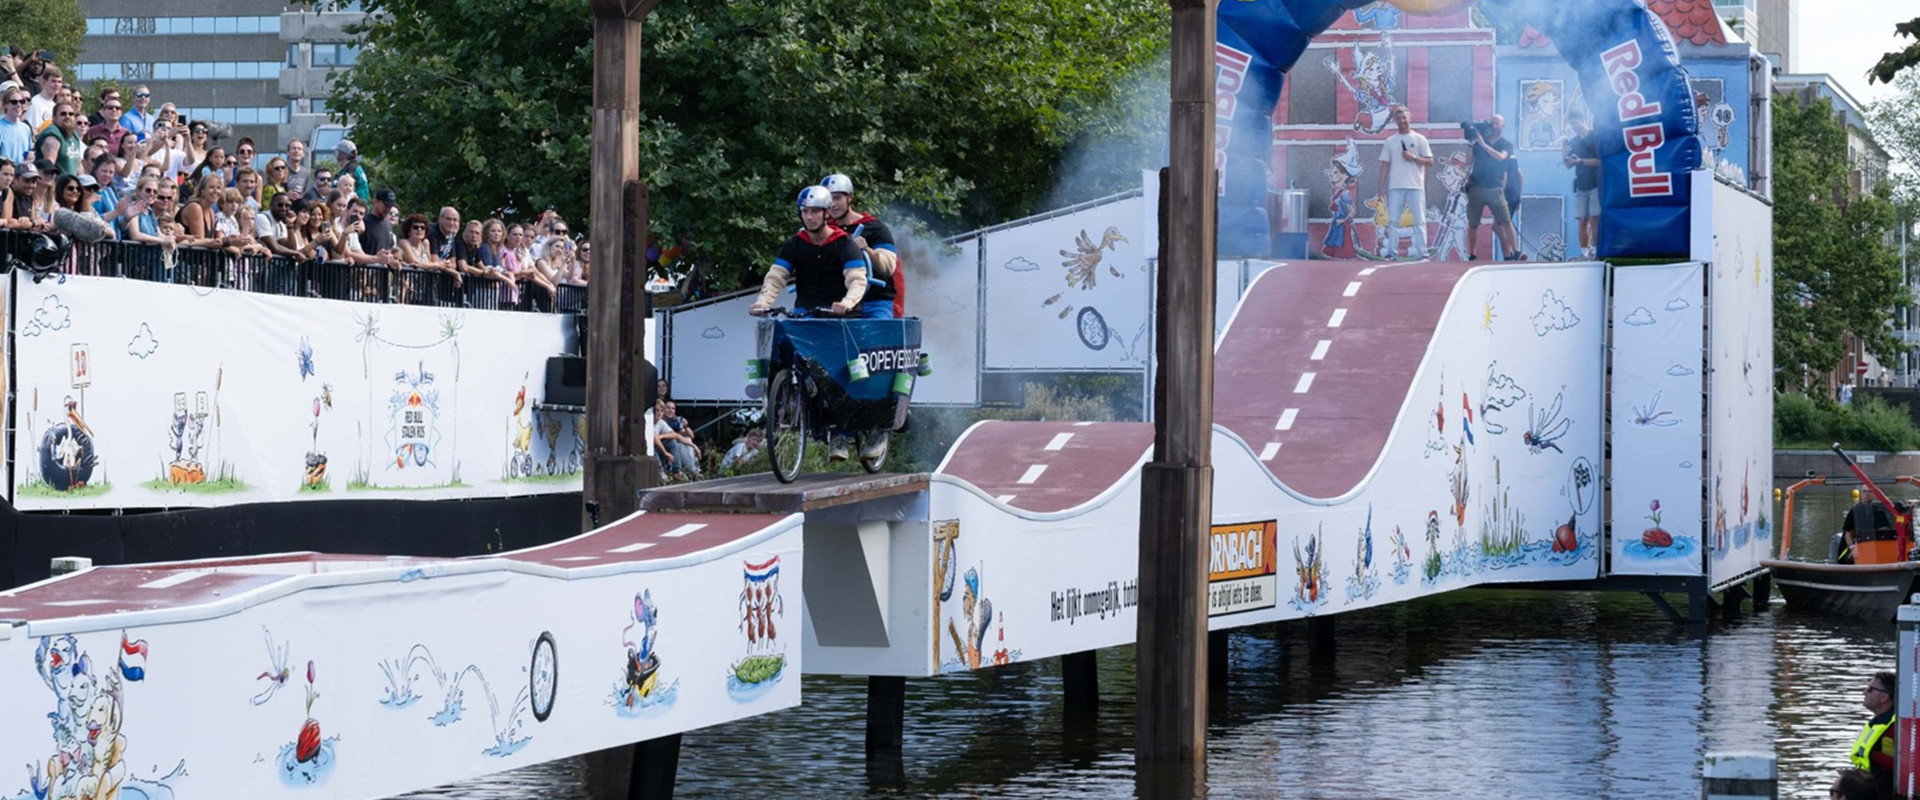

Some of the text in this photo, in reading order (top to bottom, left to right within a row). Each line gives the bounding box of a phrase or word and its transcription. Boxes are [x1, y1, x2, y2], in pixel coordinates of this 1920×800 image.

[1602, 40, 1672, 196] Red Bull
[1715, 109, 1730, 123] 10
[405, 411, 422, 423] RED BULL
[1051, 578, 1137, 625] Het lijkt onmogelijk, totd
[1218, 584, 1231, 611] altijd
[1232, 583, 1242, 604] iets
[1243, 583, 1250, 603] te
[1250, 581, 1263, 602] doen.
